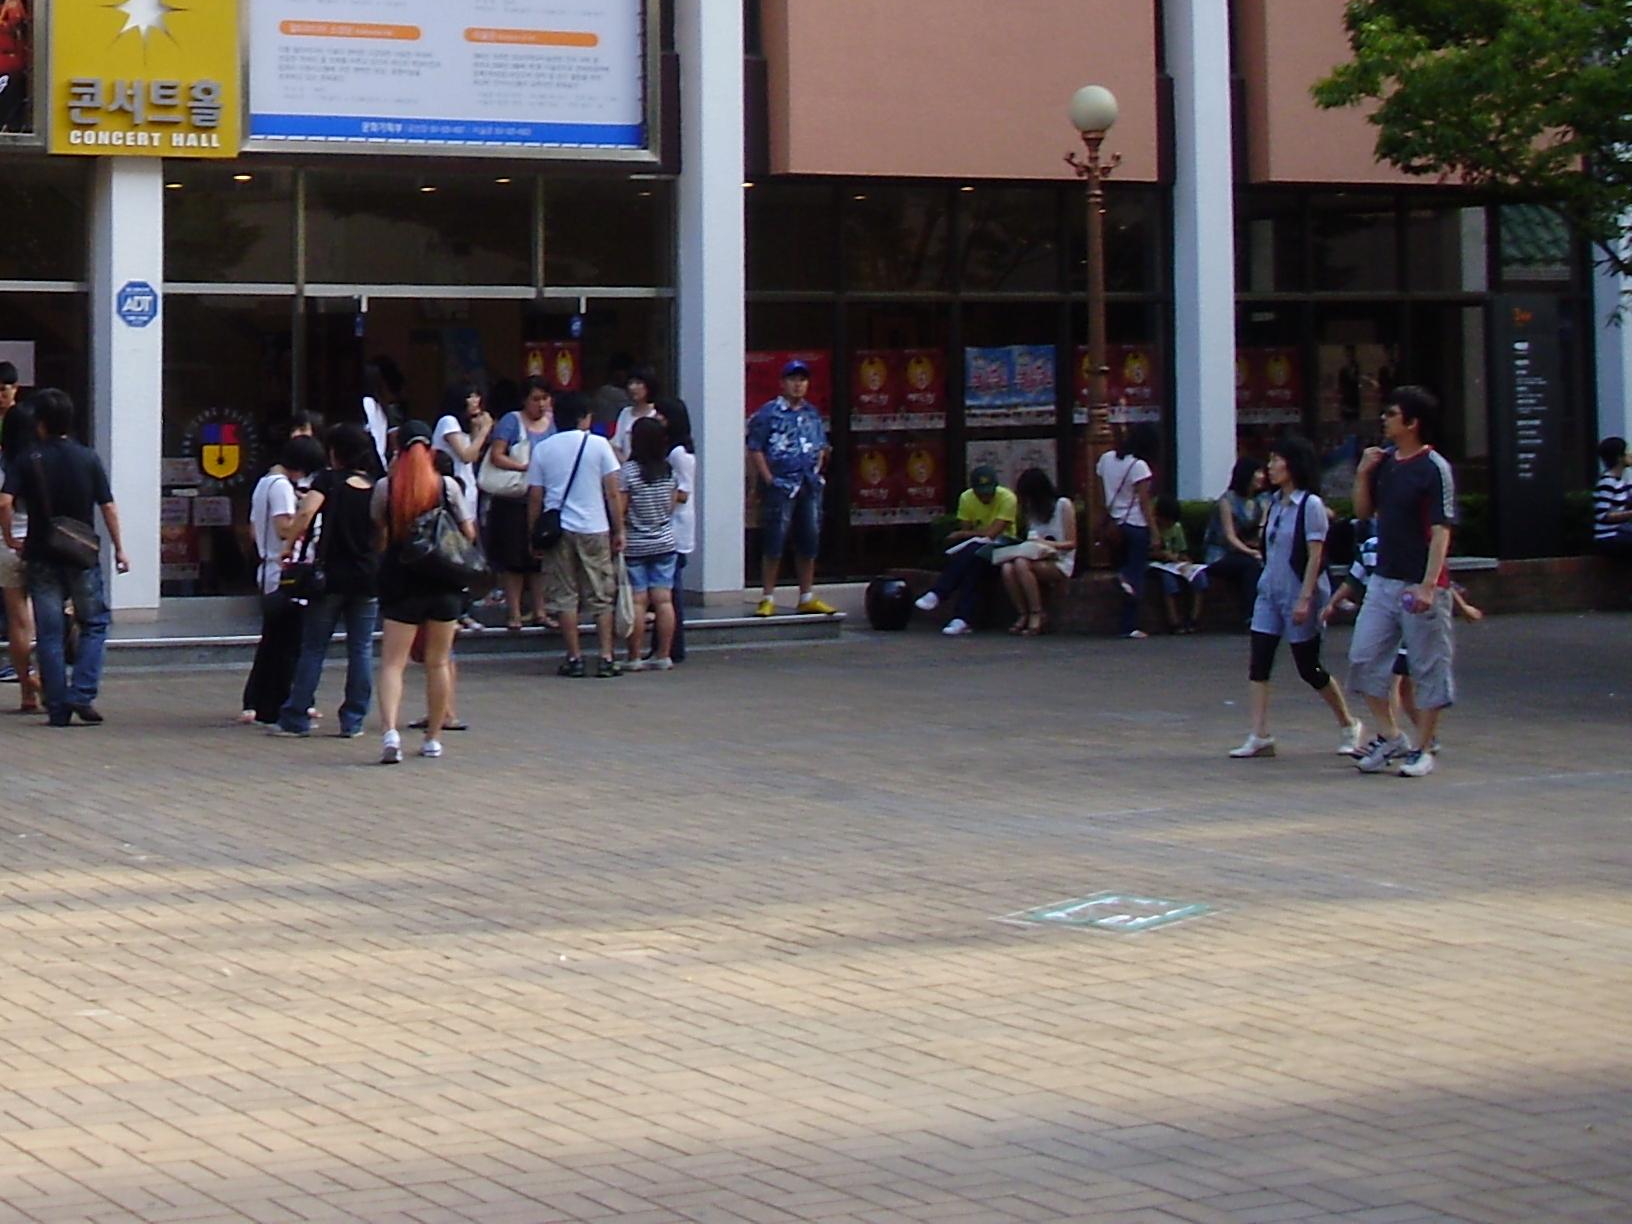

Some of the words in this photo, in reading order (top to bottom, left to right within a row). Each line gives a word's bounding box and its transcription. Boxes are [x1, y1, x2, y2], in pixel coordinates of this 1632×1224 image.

[67, 77, 222, 128] 콘서트홀
[69, 129, 162, 147] CONCERT
[171, 132, 221, 148] HALL
[121, 296, 153, 312] ADT
